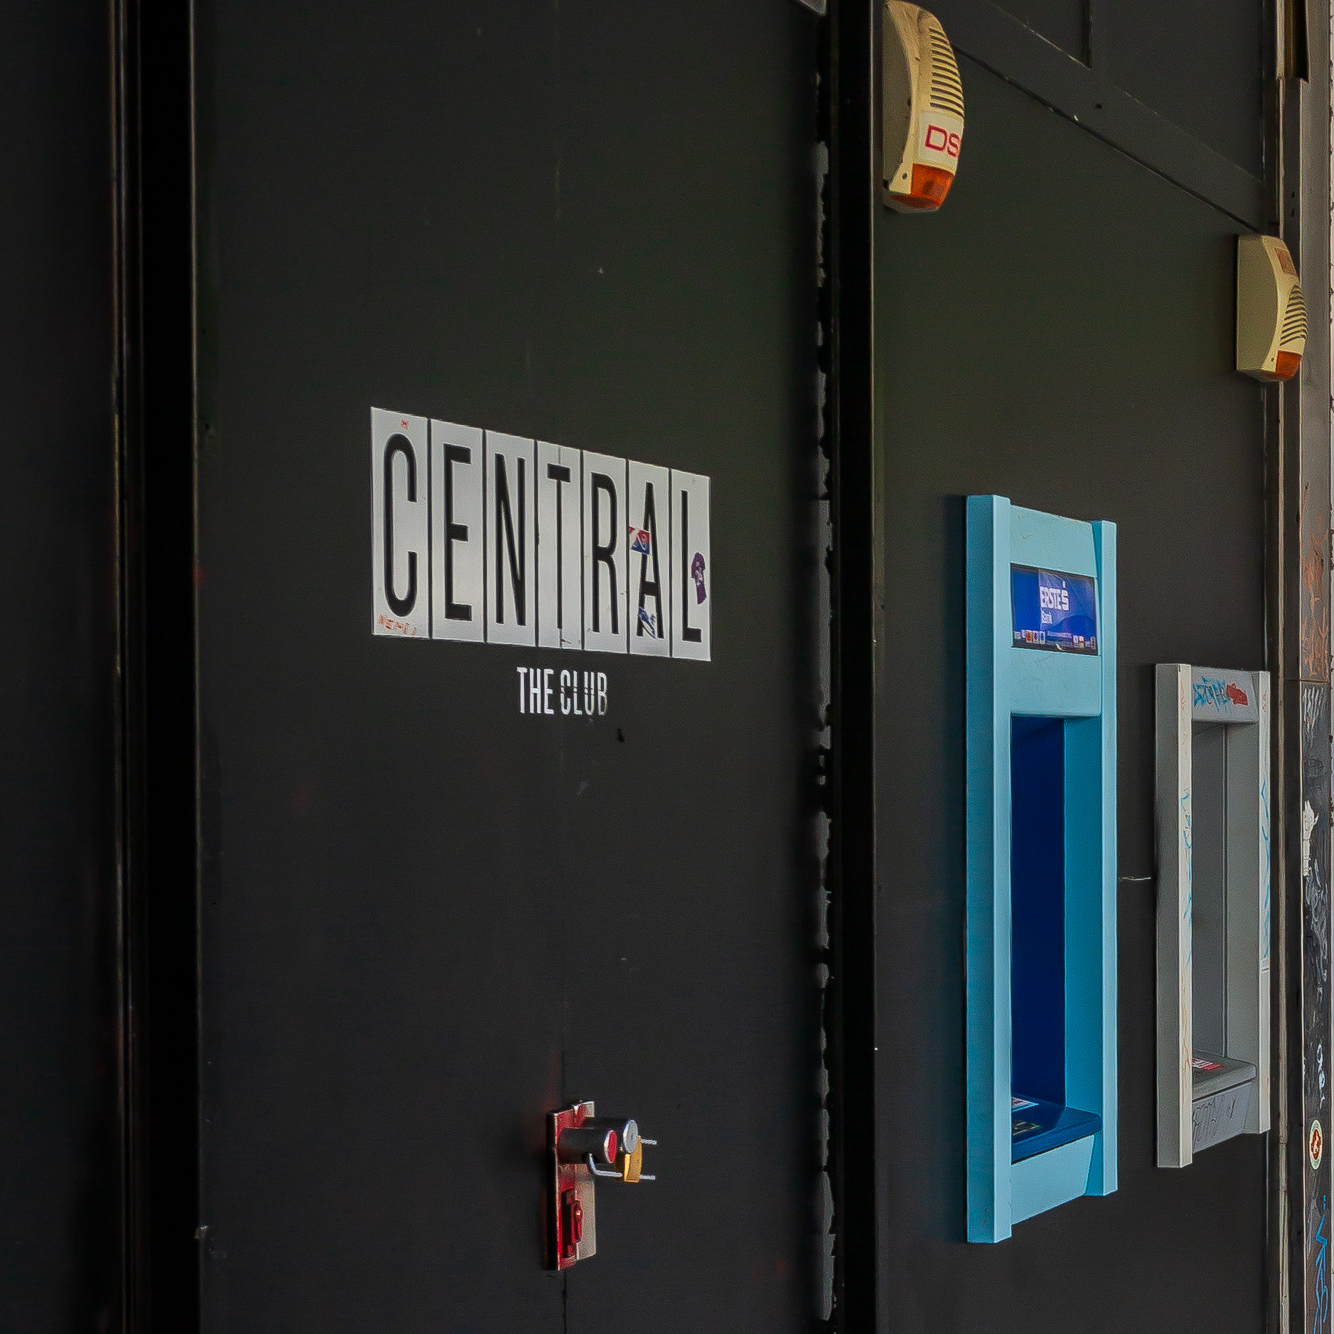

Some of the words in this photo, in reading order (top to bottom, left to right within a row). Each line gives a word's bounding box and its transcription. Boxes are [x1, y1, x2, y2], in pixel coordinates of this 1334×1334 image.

[382, 432, 703, 643] CENTRAL
[516, 666, 555, 715] THE
[560, 668, 609, 716] CLUB
